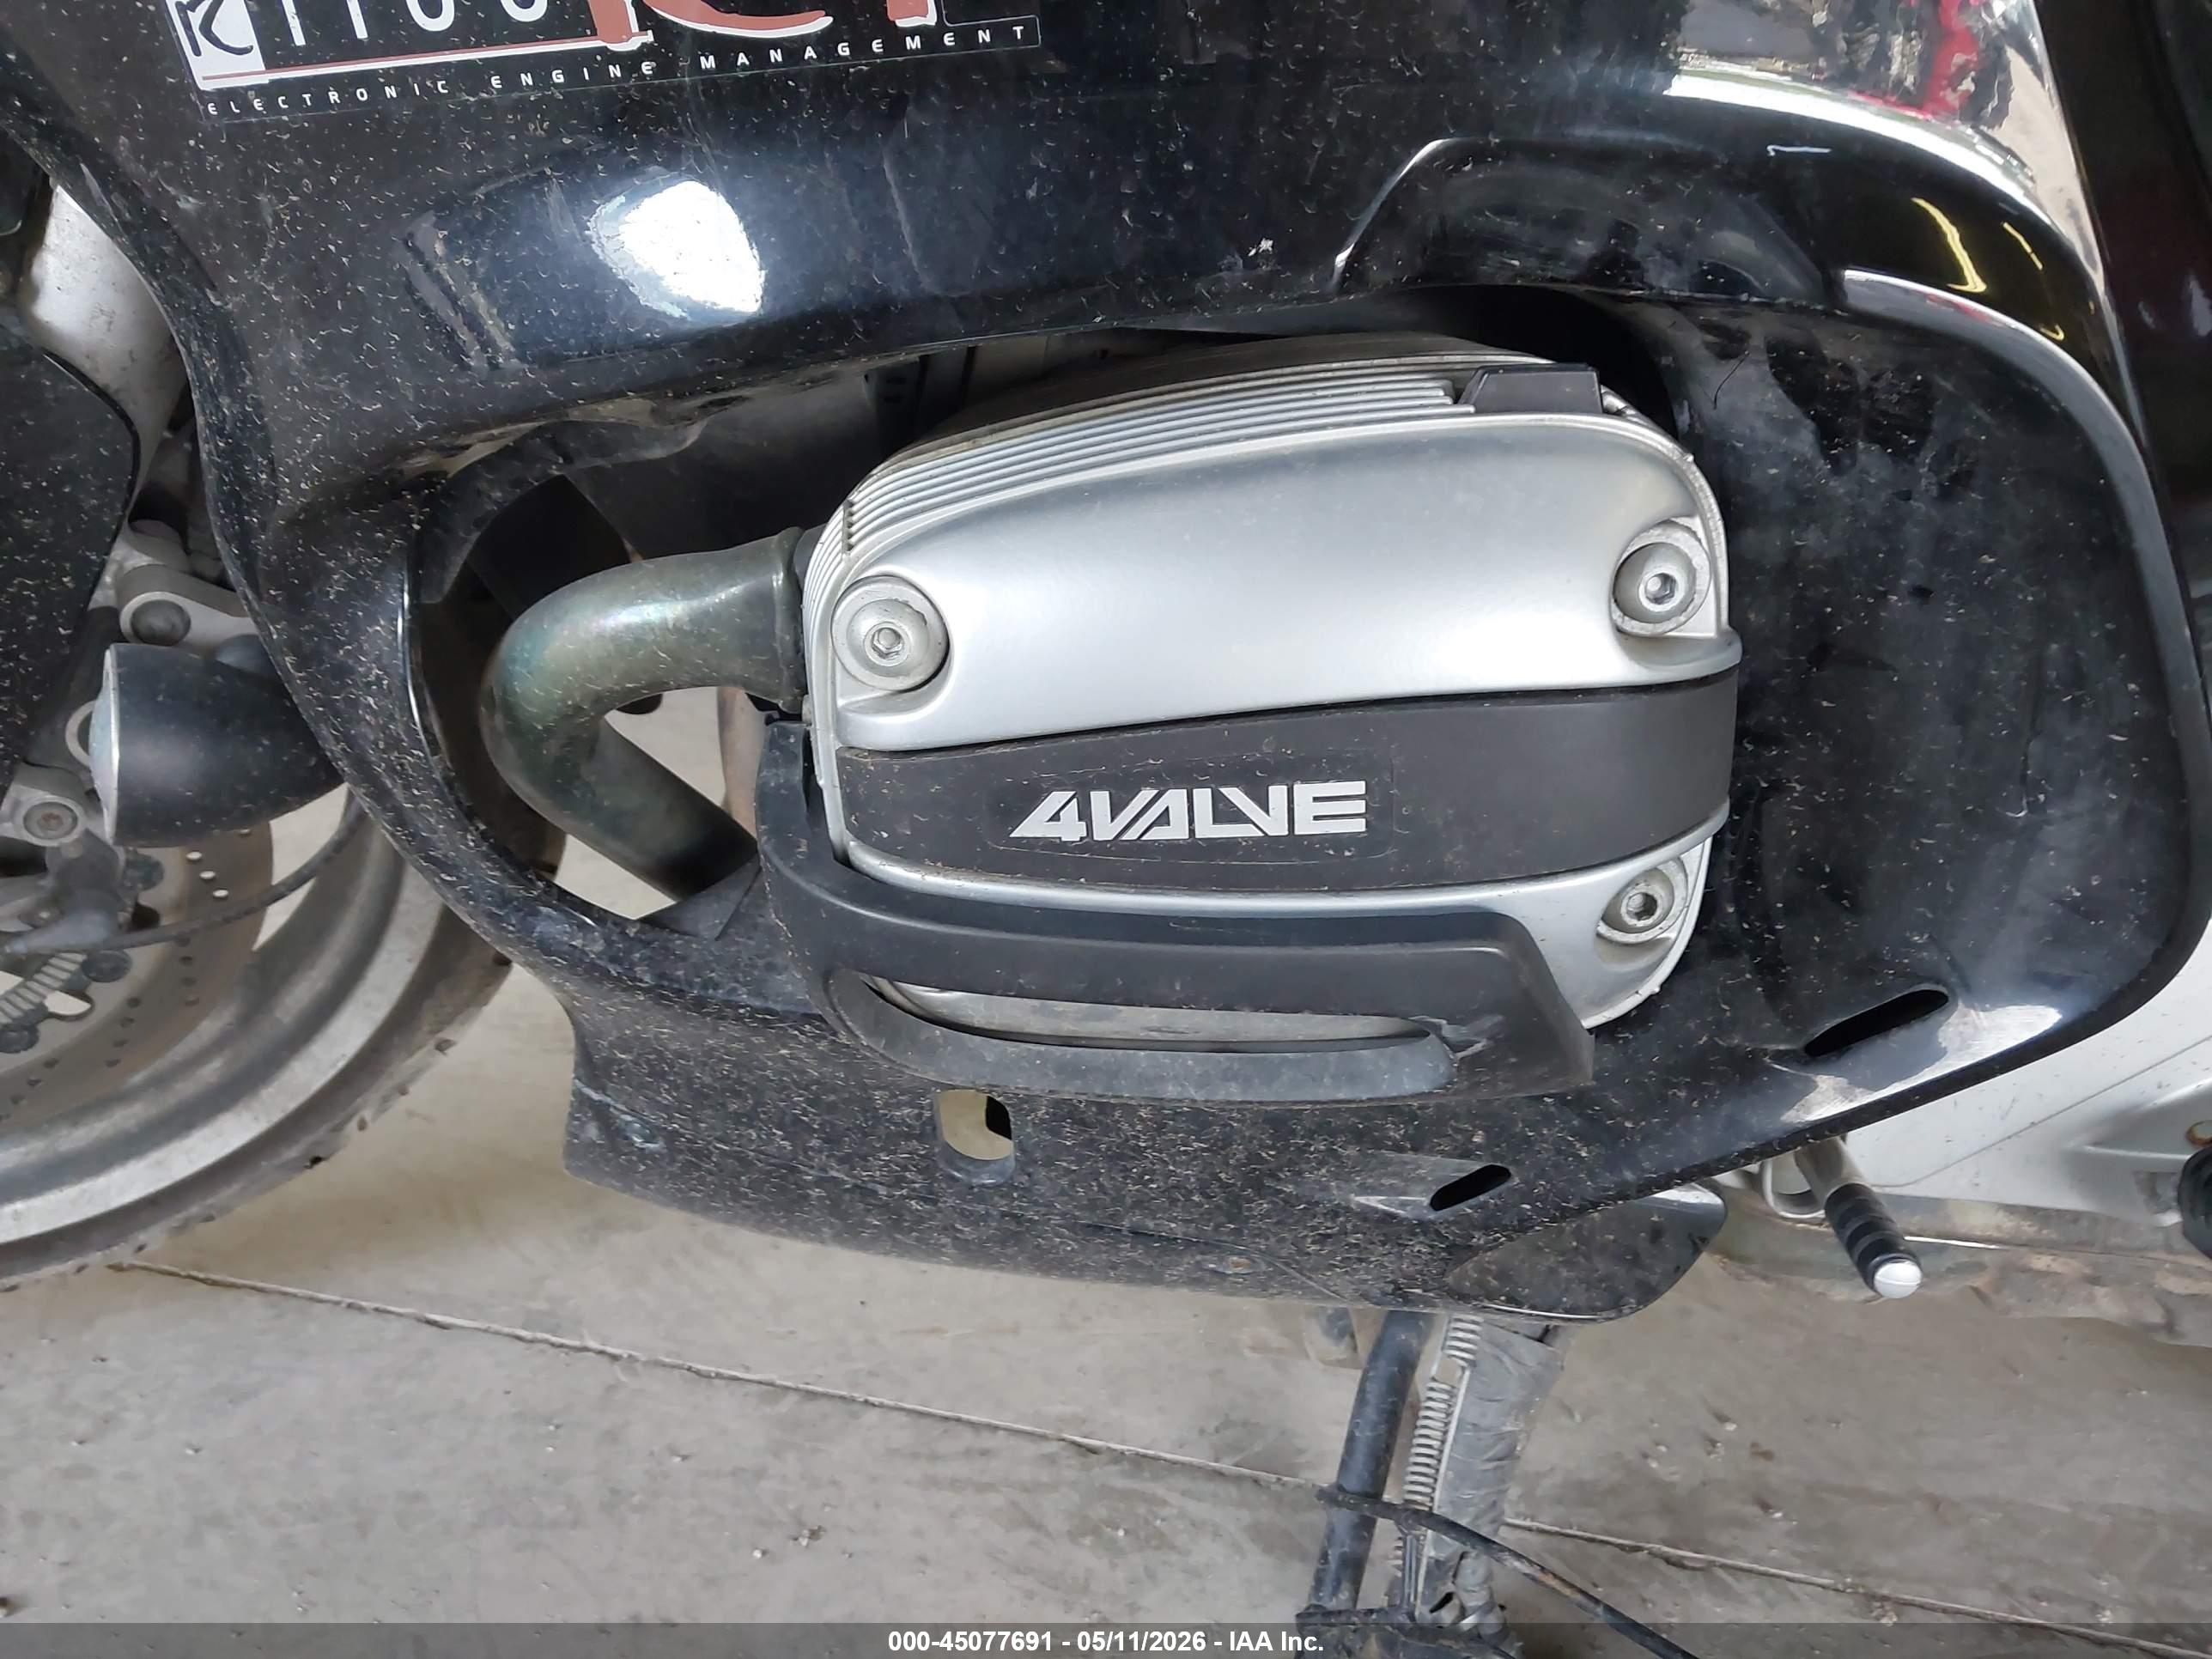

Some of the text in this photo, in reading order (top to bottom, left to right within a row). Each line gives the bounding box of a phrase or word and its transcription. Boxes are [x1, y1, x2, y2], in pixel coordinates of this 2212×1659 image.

[207, 80, 449, 116] ELECTRONIC
[490, 61, 654, 88] ENGINE
[700, 25, 1024, 70] MANAGEMENT
